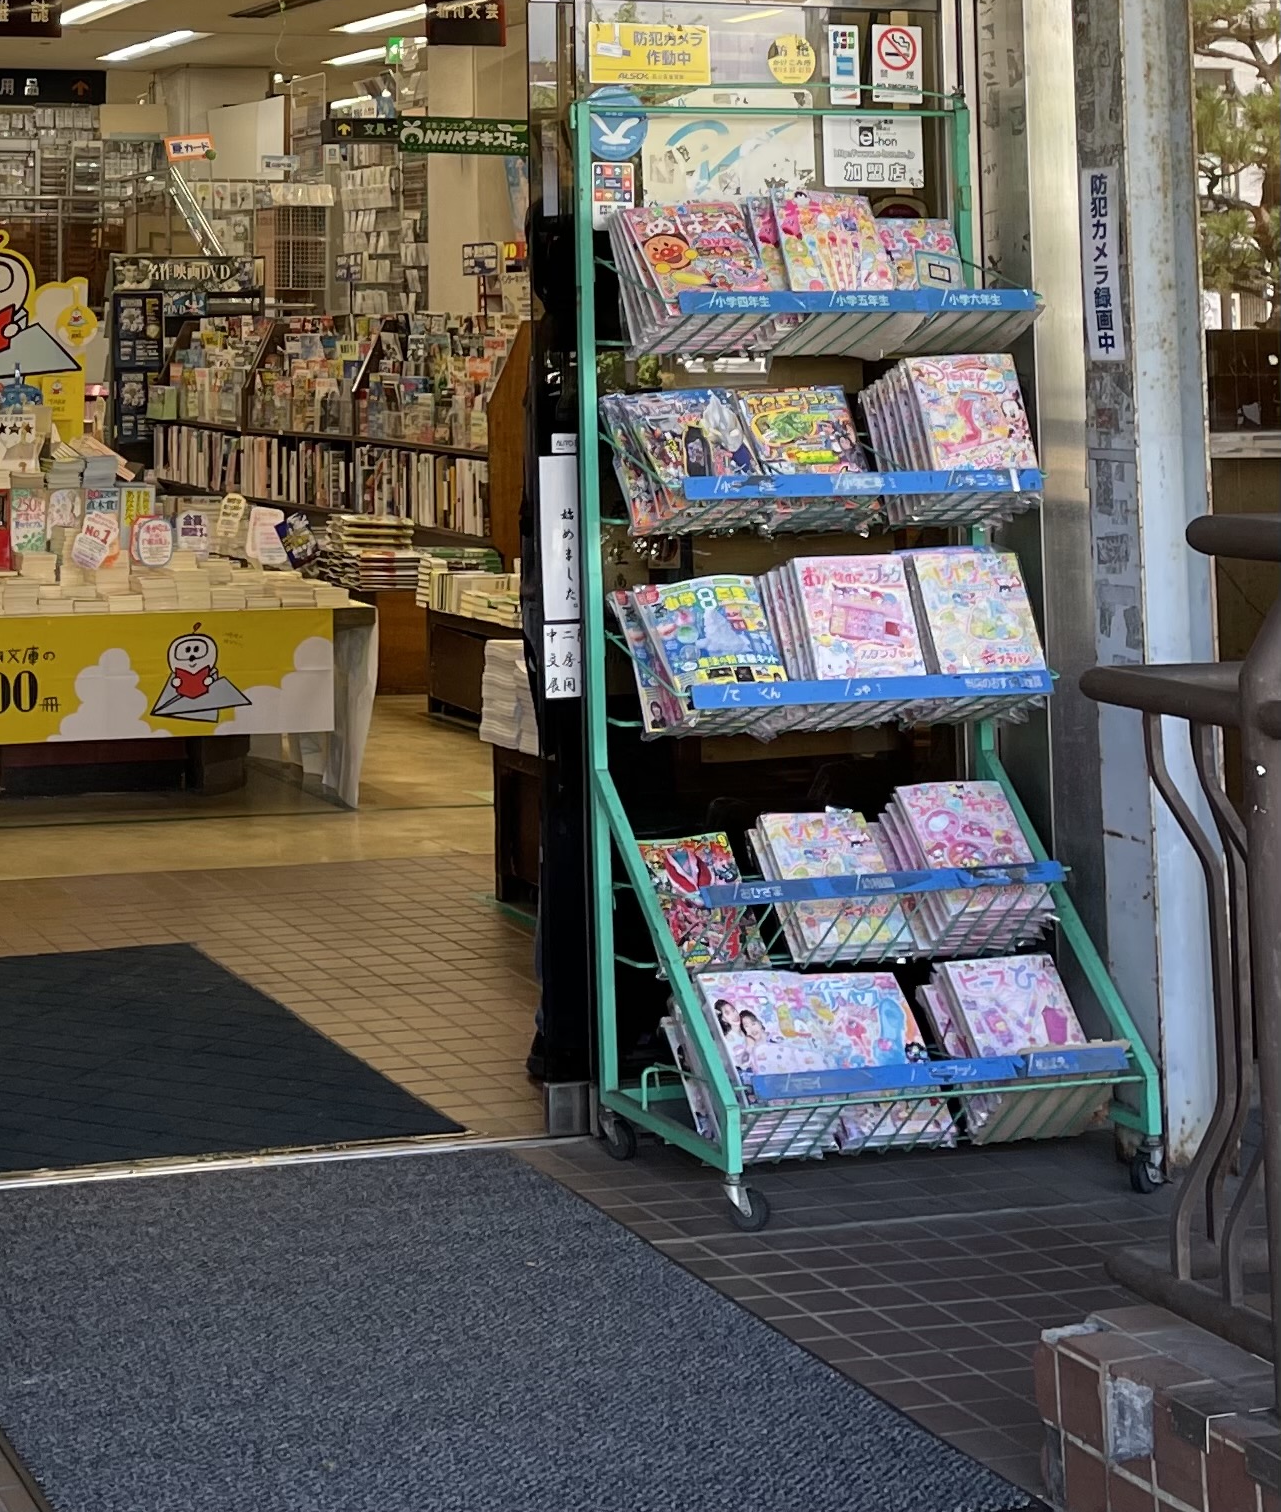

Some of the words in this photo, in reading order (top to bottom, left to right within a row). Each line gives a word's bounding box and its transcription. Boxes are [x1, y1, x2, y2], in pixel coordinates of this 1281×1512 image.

[646, 50, 692, 67] 作動中
[423, 129, 519, 148] NHKテキスト
[843, 161, 907, 183] 加盟店
[1089, 172, 1116, 355] 防犯カメラ録画中
[715, 294, 771, 309] 小学四年生
[835, 293, 891, 308] 小学五年生
[948, 293, 1003, 307] 小学六年生
